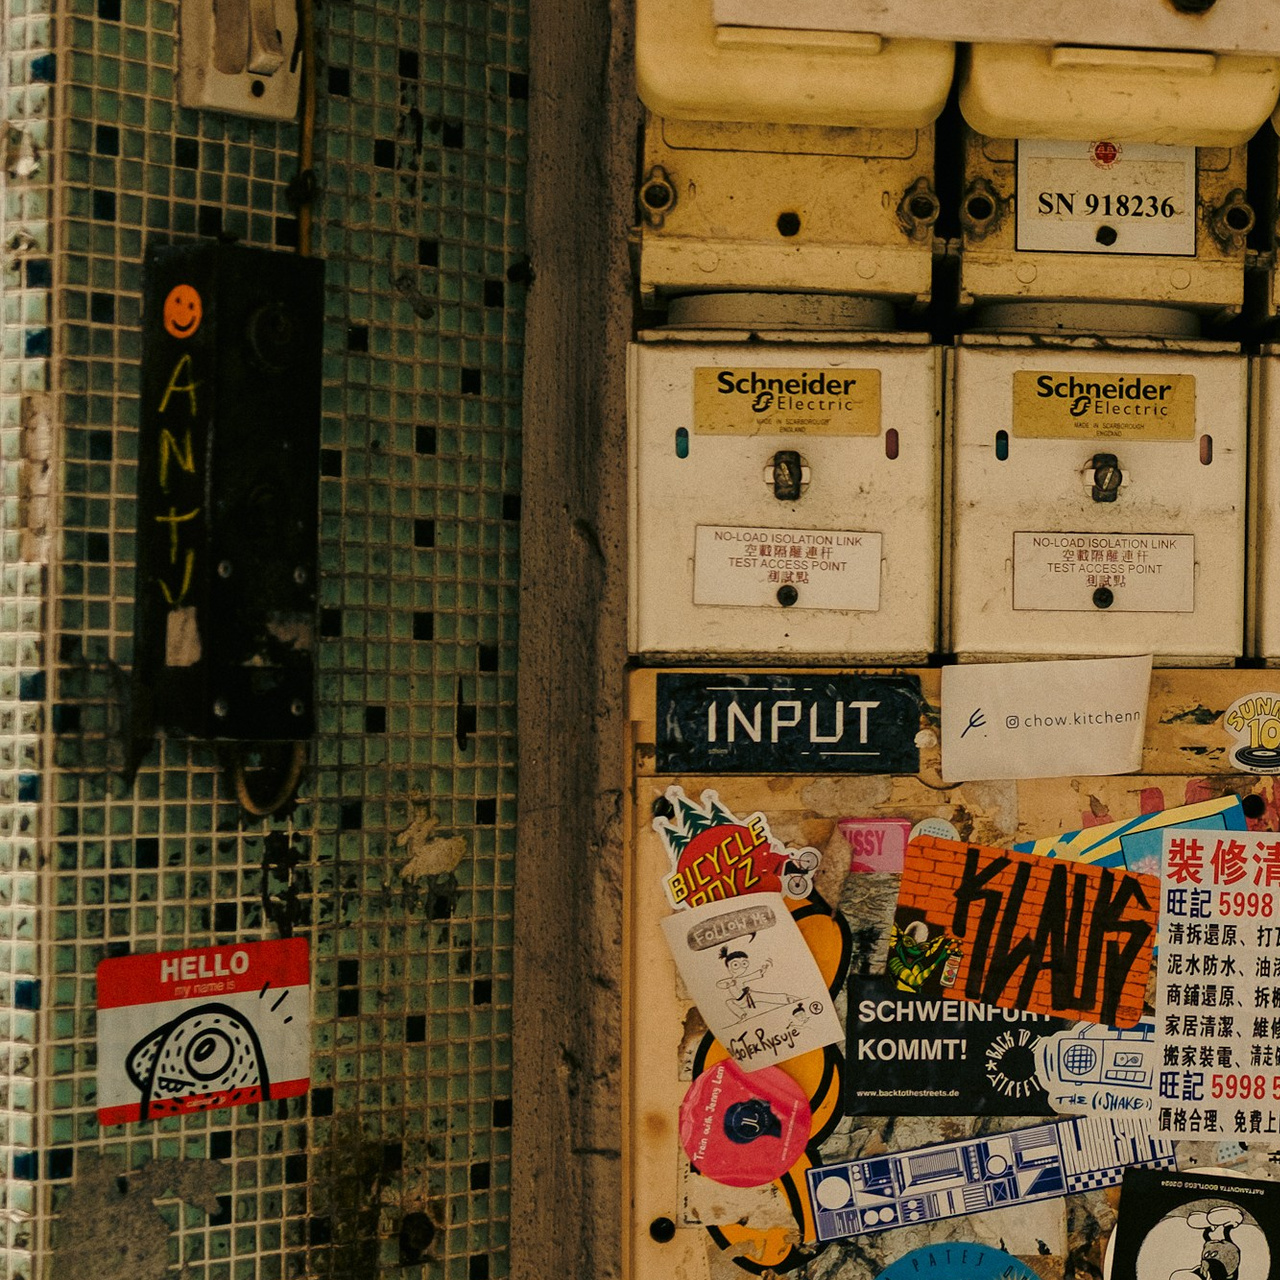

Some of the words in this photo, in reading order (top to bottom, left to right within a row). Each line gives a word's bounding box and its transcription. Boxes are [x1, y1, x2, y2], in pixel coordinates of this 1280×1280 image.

[1039, 192, 1076, 214] SN
[1086, 193, 1174, 218] 918236
[718, 371, 856, 395] Schneider
[1037, 375, 1171, 400] Schneider
[778, 396, 852, 411] Electric
[1095, 401, 1167, 415] Electric
[715, 532, 768, 542] NO-LOAD
[772, 533, 832, 545] ISOLATION
[837, 536, 862, 546] LINK
[1034, 538, 1084, 547] NO-LOAD
[1088, 539, 1147, 548] ISOLATION
[1152, 540, 1177, 549] LINK
[729, 557, 758, 568] TEST
[760, 559, 808, 569] ACCESS
[812, 561, 847, 571] POINT
[1048, 563, 1075, 572] TEST
[1079, 563, 1124, 573] ACCESS
[1128, 564, 1162, 574] POINT
[708, 700, 881, 744] INPUT
[1024, 711, 1140, 728] chow.kitchenn
[668, 816, 767, 902] BICYCLE
[1168, 888, 1211, 918] 旺記
[1219, 892, 1273, 917] 5998
[160, 951, 249, 983] HELLO
[175, 987, 188, 997] my
[194, 983, 224, 994] name
[226, 980, 235, 990] is
[857, 1039, 967, 1060] KOMMT!
[986, 1033, 1015, 1060] BACK
[1159, 1071, 1204, 1100] 旺記
[1212, 1075, 1266, 1099] 5998
